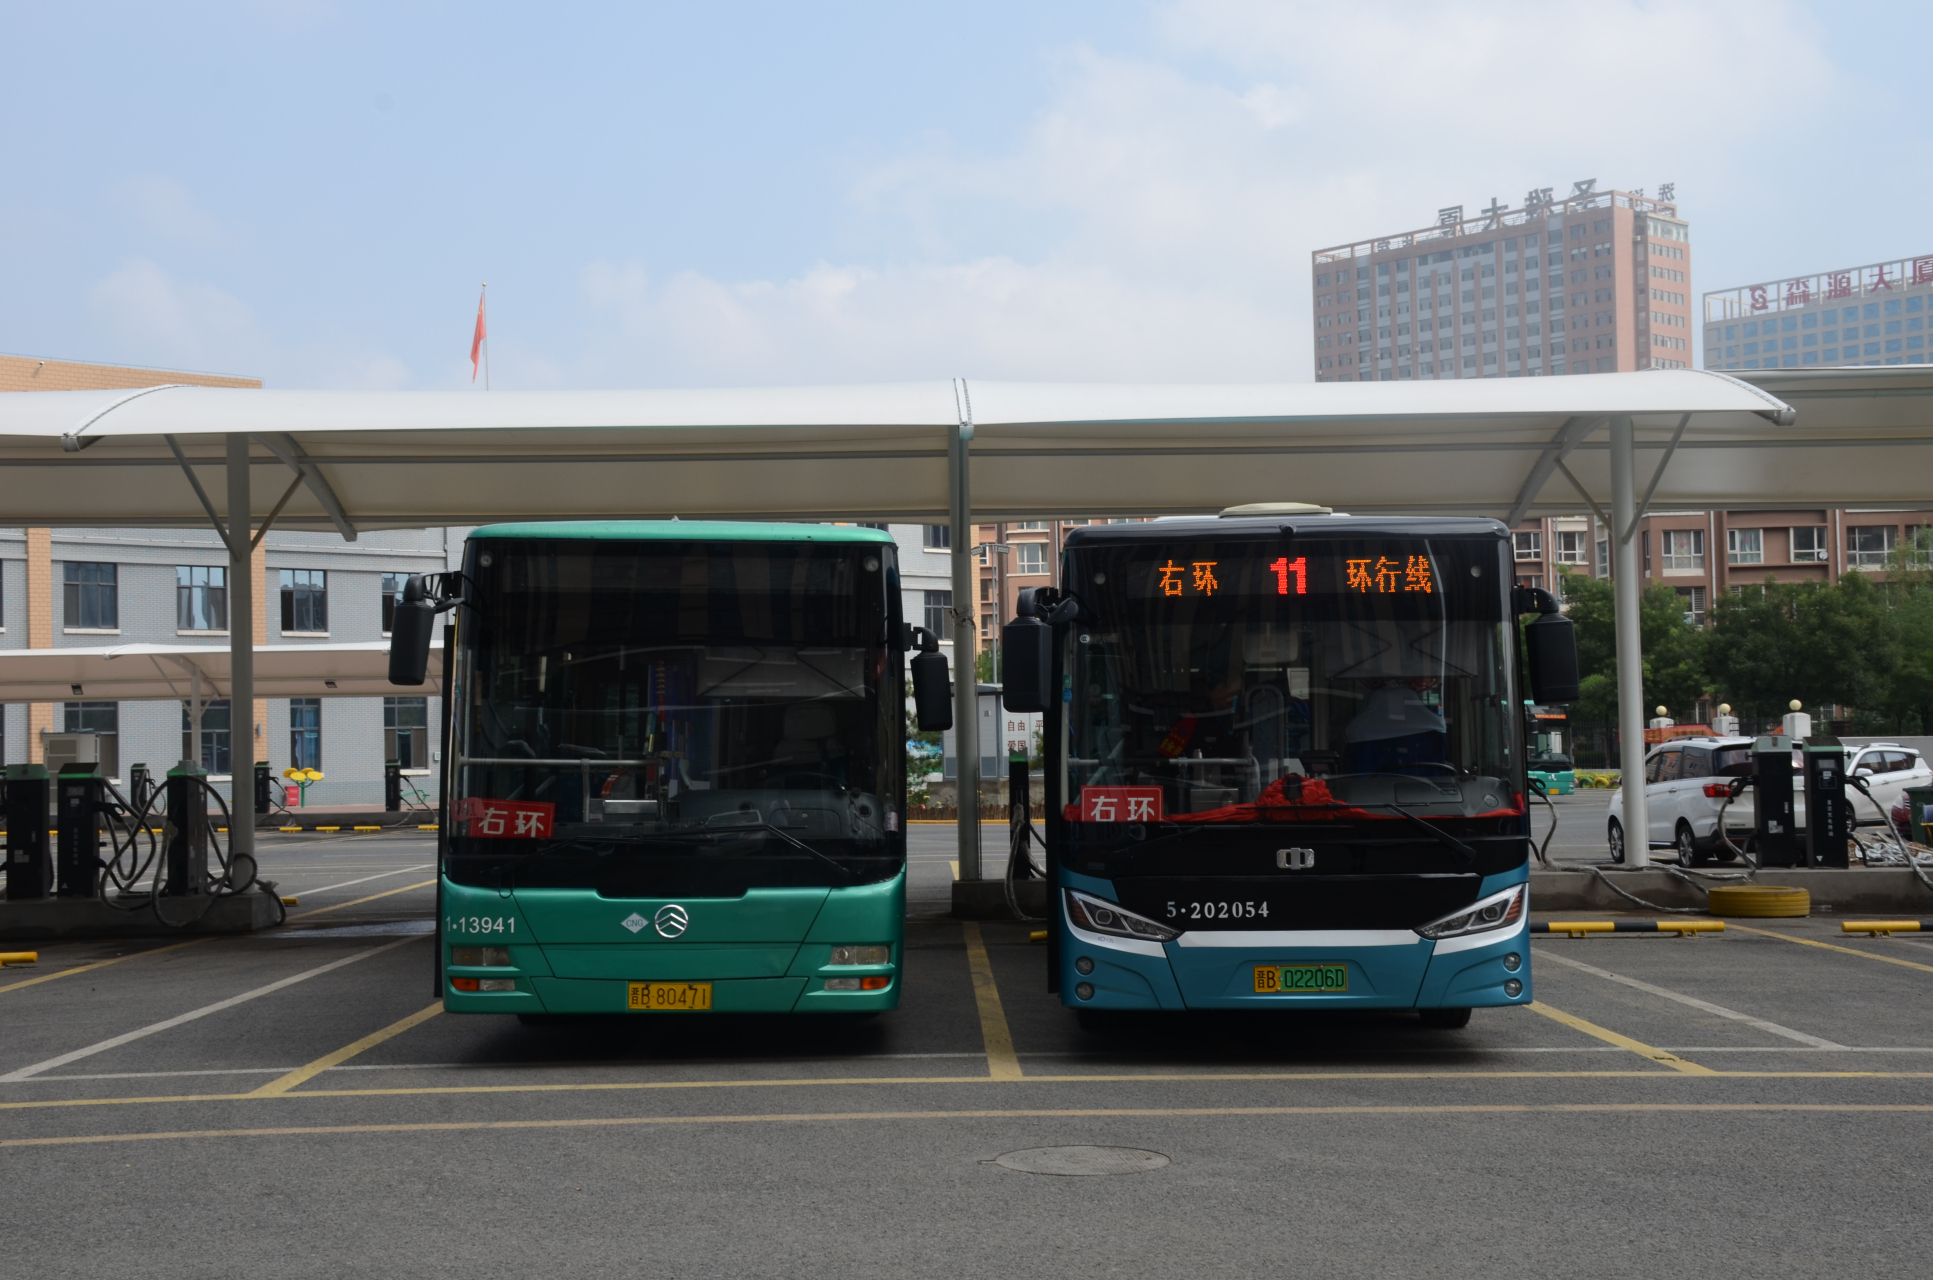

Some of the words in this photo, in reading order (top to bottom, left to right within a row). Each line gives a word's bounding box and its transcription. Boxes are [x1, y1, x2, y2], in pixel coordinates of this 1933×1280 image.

[1786, 255, 1933, 306] 森源大厦
[1159, 559, 1218, 596] 右环
[1270, 557, 1307, 594] 11
[1345, 556, 1432, 593] 环行线
[1008, 720, 1025, 731] 自由
[478, 807, 545, 838] 右环
[1090, 795, 1155, 822] 右环
[626, 917, 644, 928] CNG
